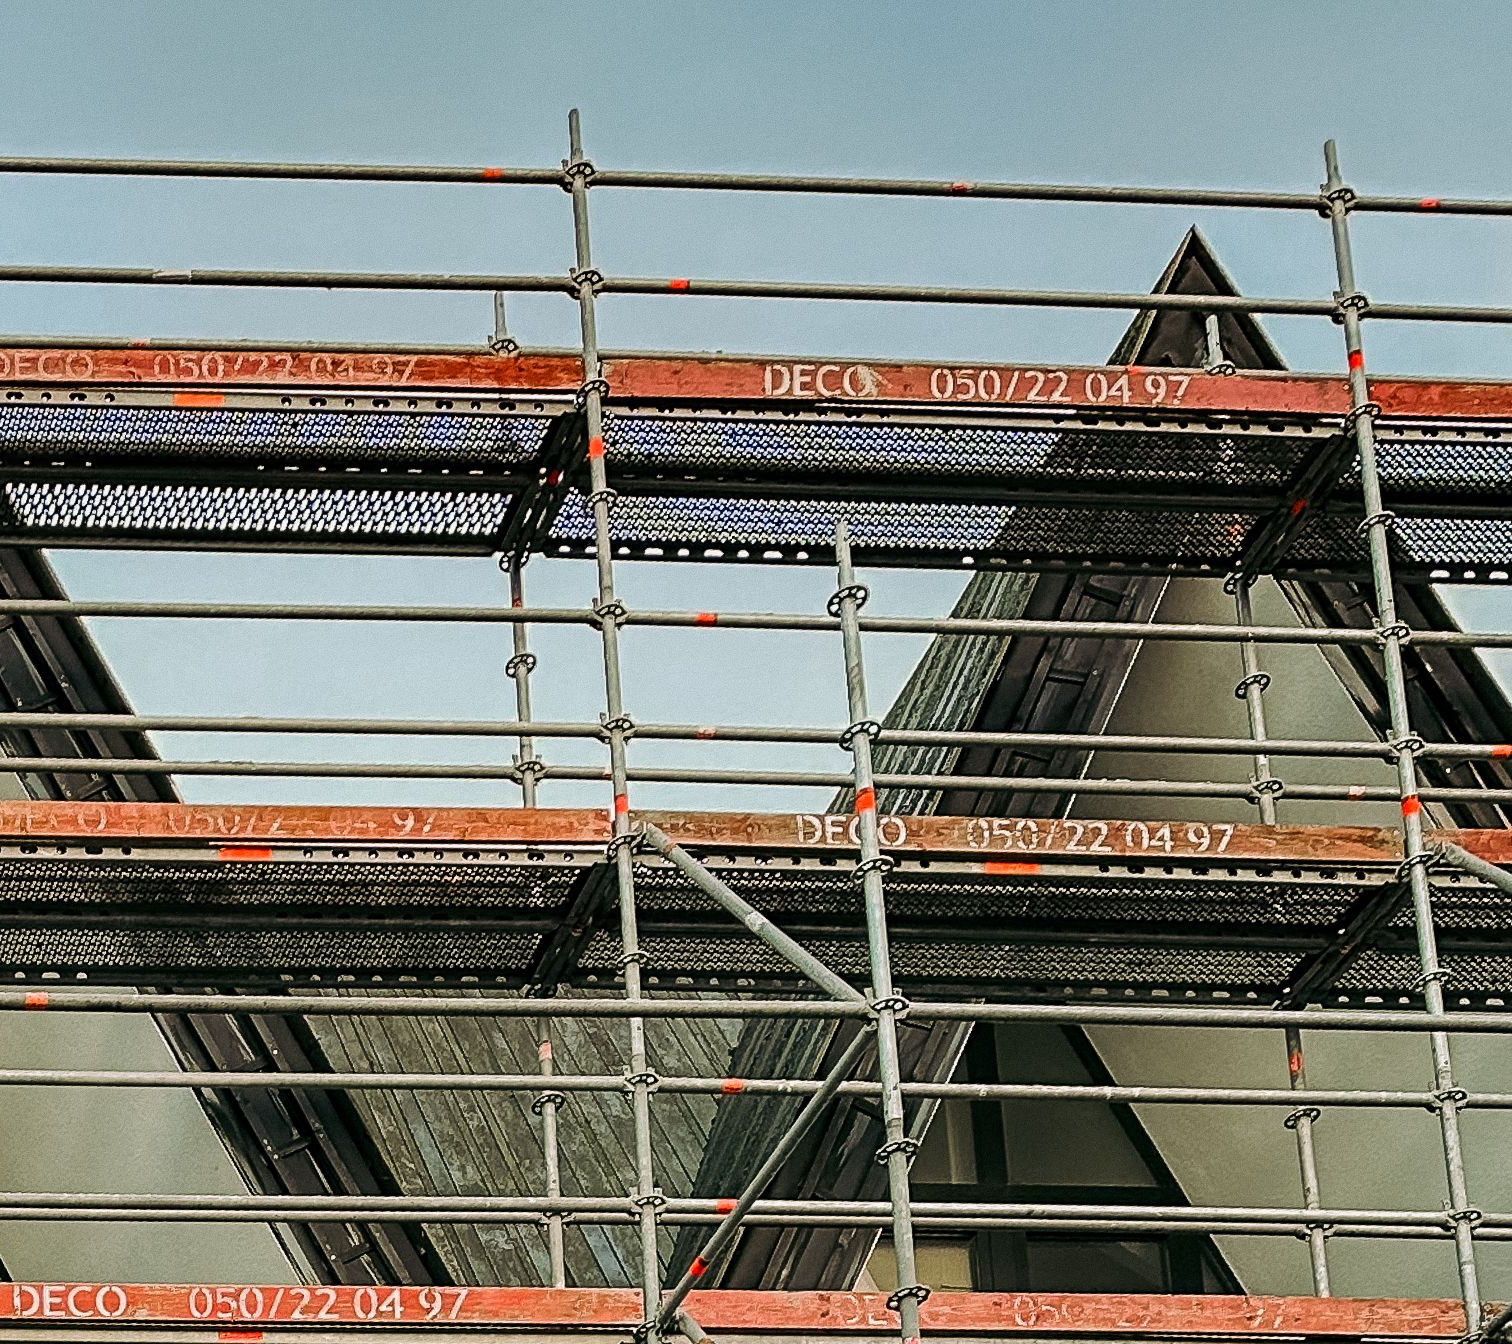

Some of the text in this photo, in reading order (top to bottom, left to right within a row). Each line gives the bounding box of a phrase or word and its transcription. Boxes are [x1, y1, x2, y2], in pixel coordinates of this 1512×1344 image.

[764, 363, 1192, 407] DECO 050/22 04 97
[967, 819, 1113, 852] 050/22
[1125, 821, 1174, 852] 04
[1188, 823, 1235, 854] 97
[13, 1285, 468, 1321] DECO 050/22 04 97
